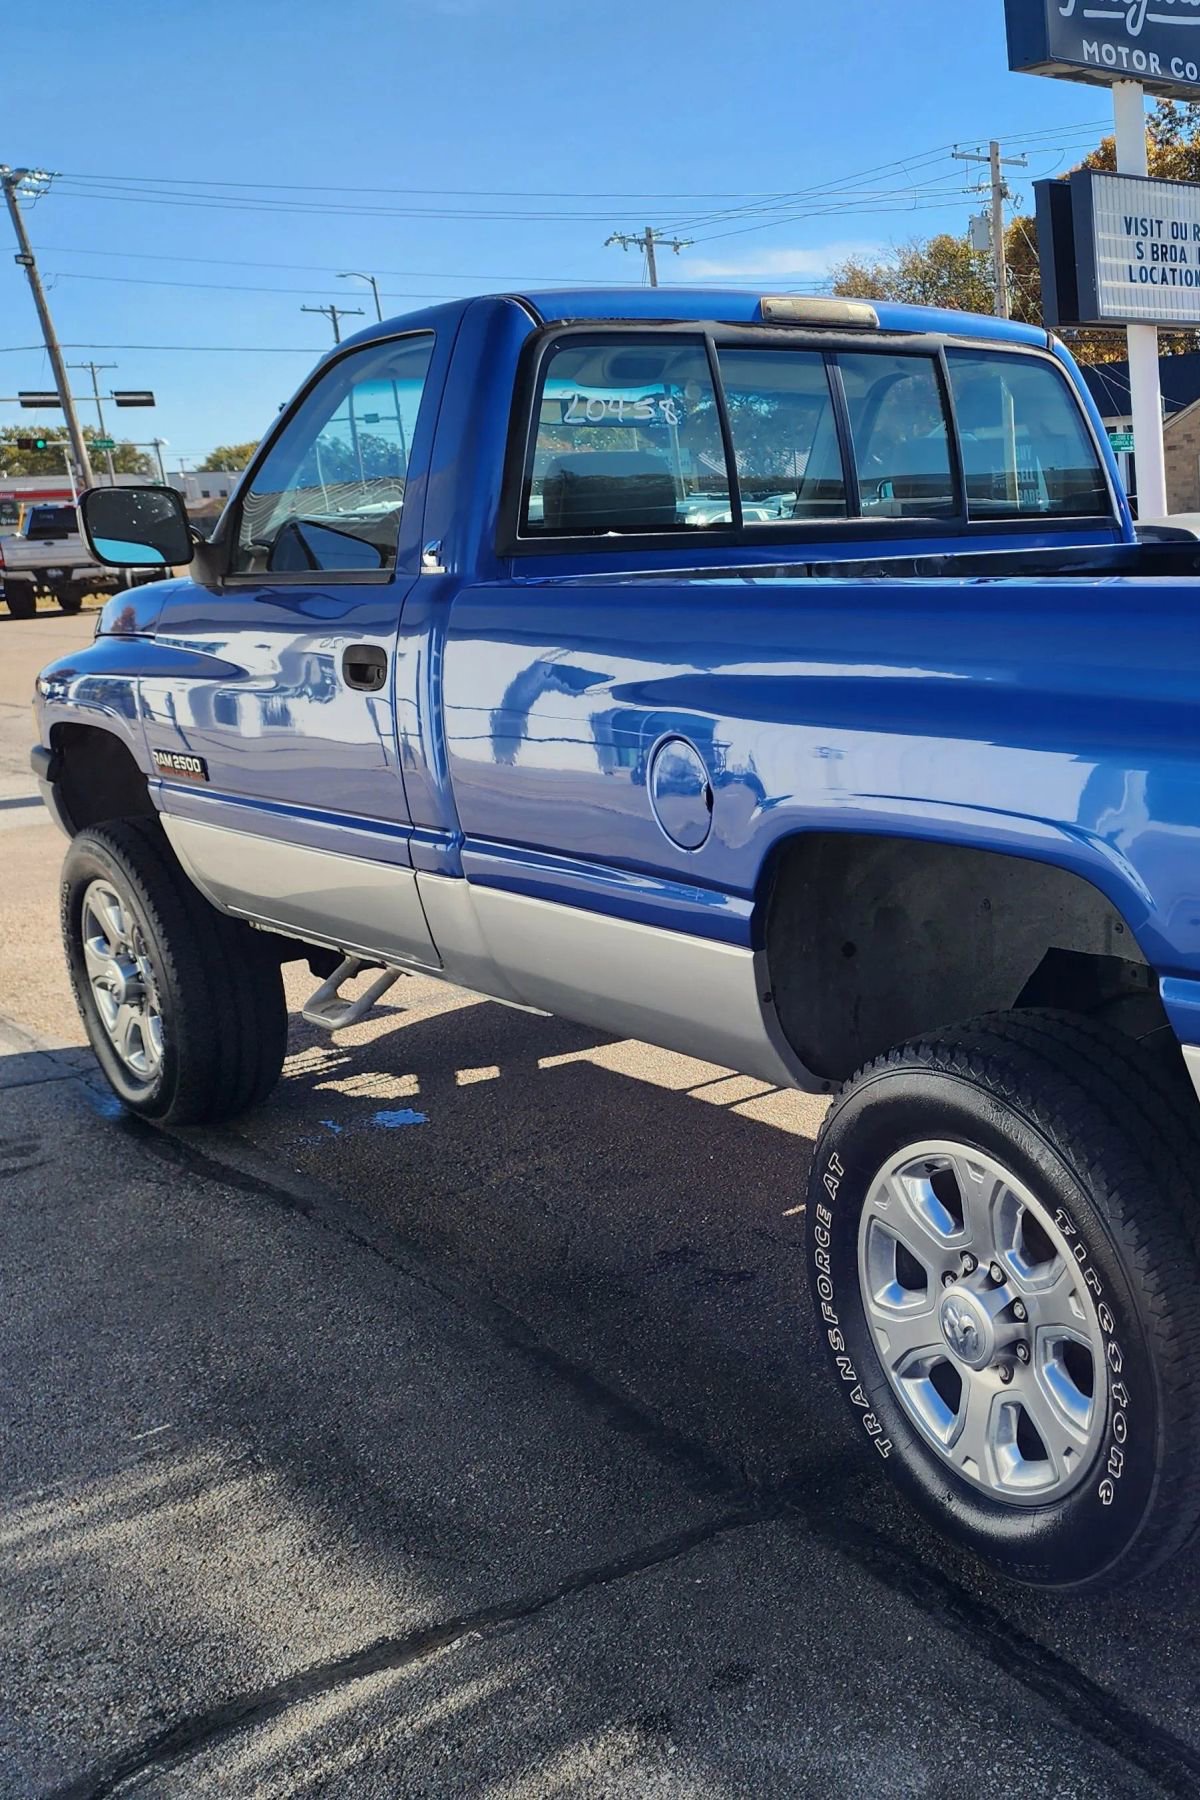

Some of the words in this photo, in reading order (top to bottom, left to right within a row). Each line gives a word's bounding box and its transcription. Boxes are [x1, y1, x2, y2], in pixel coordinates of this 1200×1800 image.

[1082, 39, 1162, 75] MOTOR
[1123, 215, 1164, 239] VISIT
[1135, 241, 1145, 260] S
[560, 389, 679, 426] 20458
[152, 751, 174, 768] RAM
[172, 754, 202, 773] 2500
[822, 1152, 846, 1201] AT
[814, 1203, 894, 1459] TRANSFORCE
